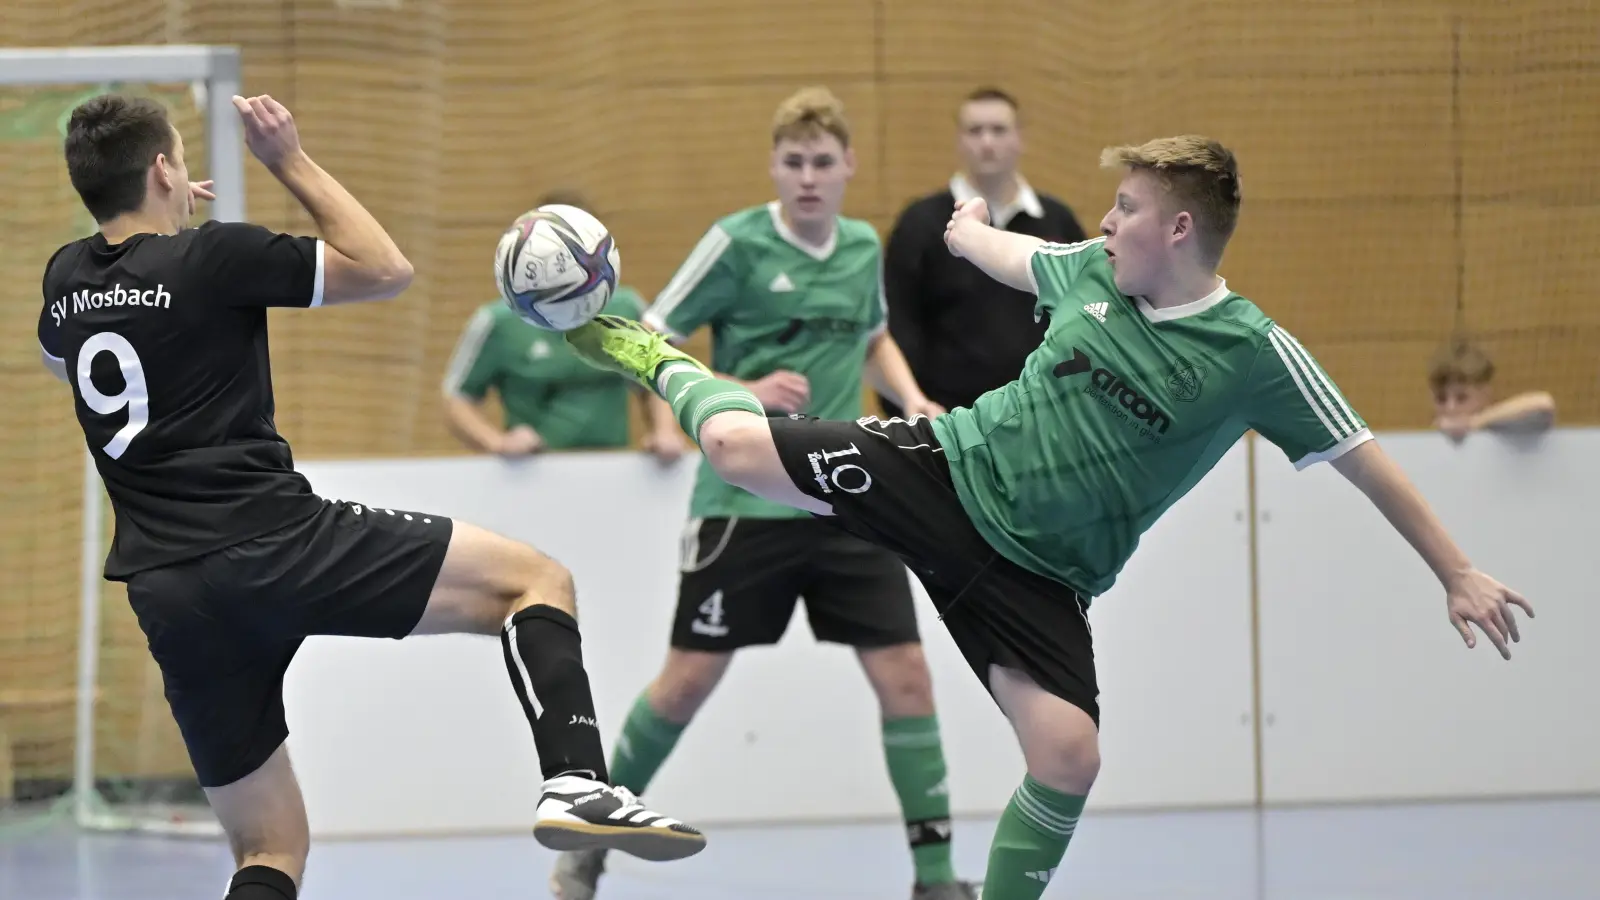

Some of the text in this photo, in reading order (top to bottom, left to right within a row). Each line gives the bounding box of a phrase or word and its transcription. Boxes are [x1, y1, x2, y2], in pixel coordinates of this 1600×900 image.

[50, 283, 171, 327] SV Mosbach
[1083, 302, 1108, 323] adidas
[77, 331, 149, 460] 9
[1091, 367, 1170, 435] arcon
[821, 441, 872, 494] 10
[698, 588, 725, 625] 4
